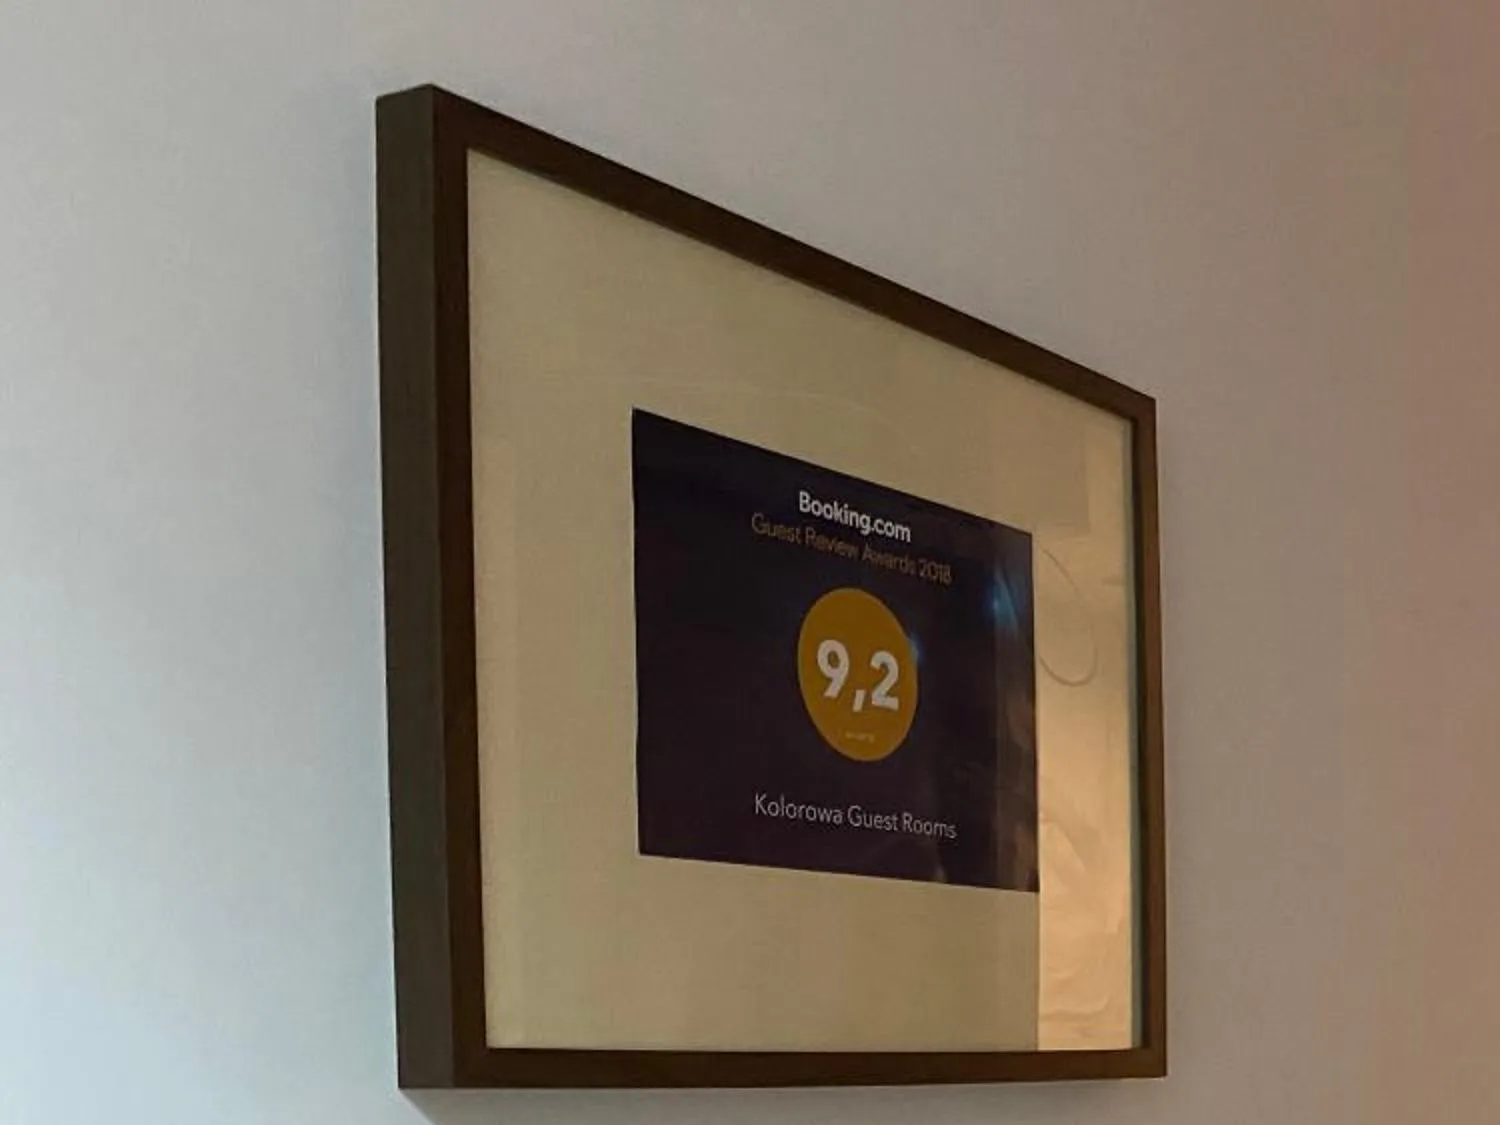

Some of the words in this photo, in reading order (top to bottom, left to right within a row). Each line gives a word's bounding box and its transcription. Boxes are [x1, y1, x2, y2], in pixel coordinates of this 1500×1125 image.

[799, 490, 912, 543] Booking.com
[750, 512, 801, 544] Guest
[804, 526, 860, 558] Review
[861, 541, 916, 576] Awards
[917, 557, 953, 585] 2018
[816, 638, 900, 713] 9,2
[754, 792, 845, 825] Kolorowa
[847, 804, 899, 832] Guest
[902, 811, 958, 840] Rooms
